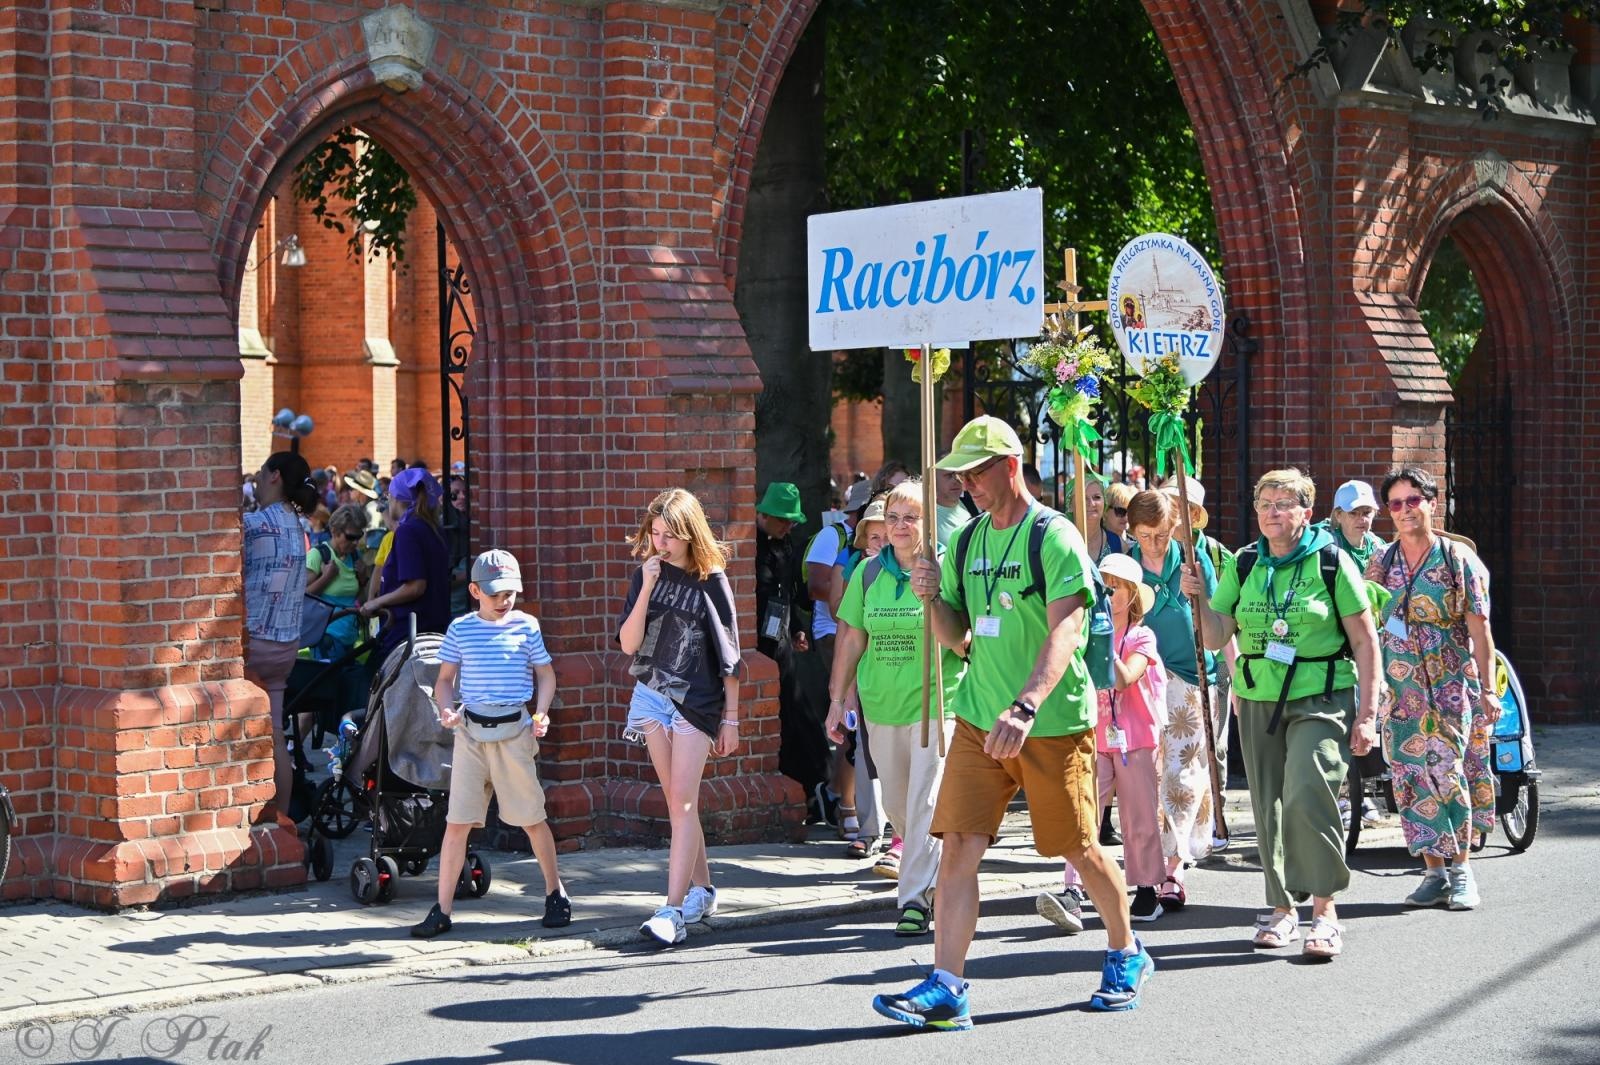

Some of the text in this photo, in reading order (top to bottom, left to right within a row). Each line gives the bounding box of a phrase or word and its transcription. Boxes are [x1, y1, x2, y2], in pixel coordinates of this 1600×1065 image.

[815, 230, 1036, 313] Racibórz
[1110, 275, 1121, 329] OPOLSKA
[1118, 239, 1174, 272] PIELGRZYMKA
[1176, 245, 1191, 260] NA
[1128, 330, 1210, 357] KIETRZ
